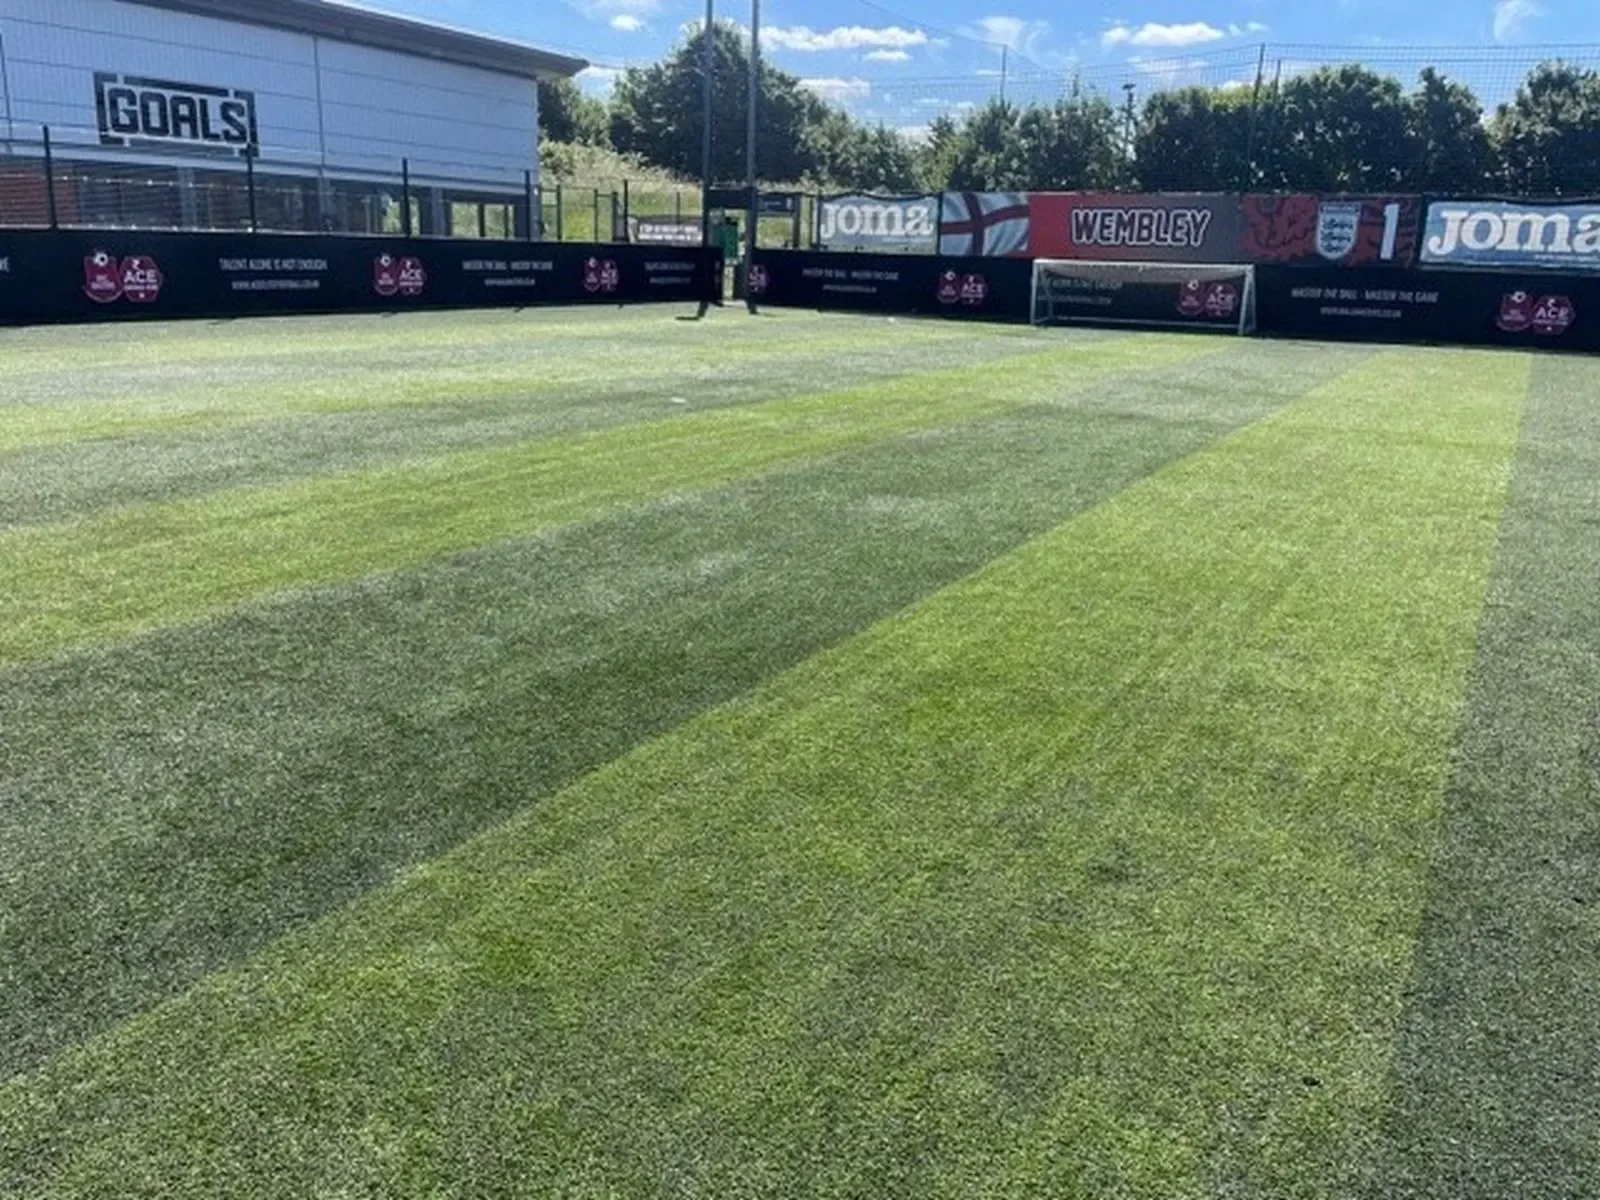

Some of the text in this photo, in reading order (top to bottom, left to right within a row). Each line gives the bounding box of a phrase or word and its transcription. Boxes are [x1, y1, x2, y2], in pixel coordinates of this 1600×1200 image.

[107, 86, 247, 144] GOALS
[1072, 208, 1212, 247] WEMBLEY
[123, 269, 158, 284] ACE
[400, 269, 422, 280] ACE
[962, 283, 984, 293] ACE
[1535, 306, 1569, 319] ACE
